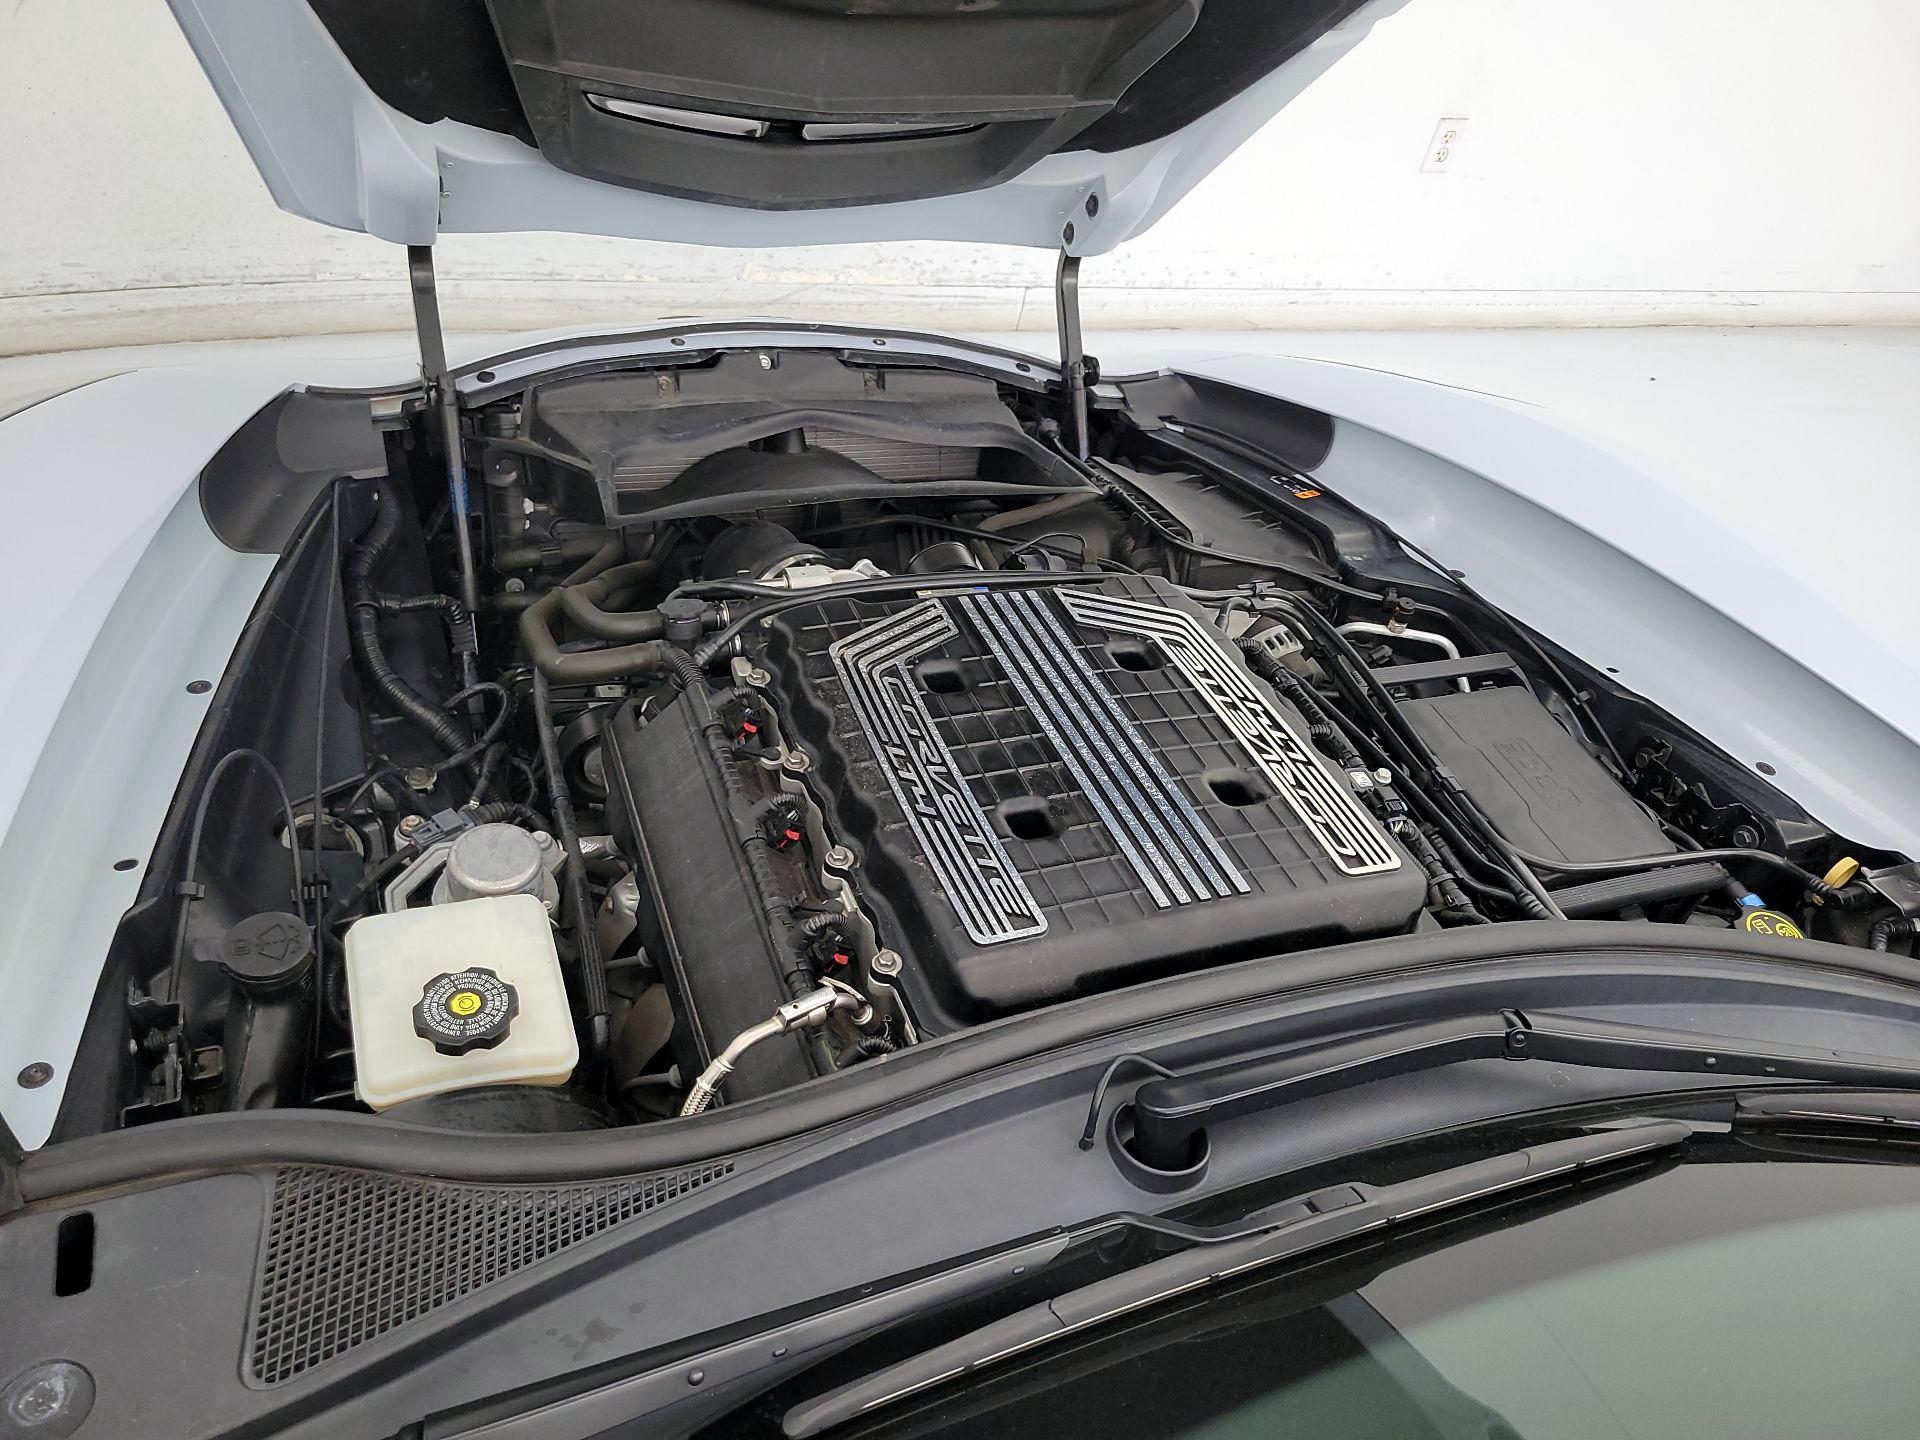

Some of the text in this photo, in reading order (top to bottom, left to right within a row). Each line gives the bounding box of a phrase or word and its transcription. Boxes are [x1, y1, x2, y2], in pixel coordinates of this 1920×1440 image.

[882, 676, 1031, 917] CORVETTE
[886, 745, 937, 816] LT4
[1169, 644, 1357, 857] CORVETTE
[1243, 699, 1308, 763] LT4
